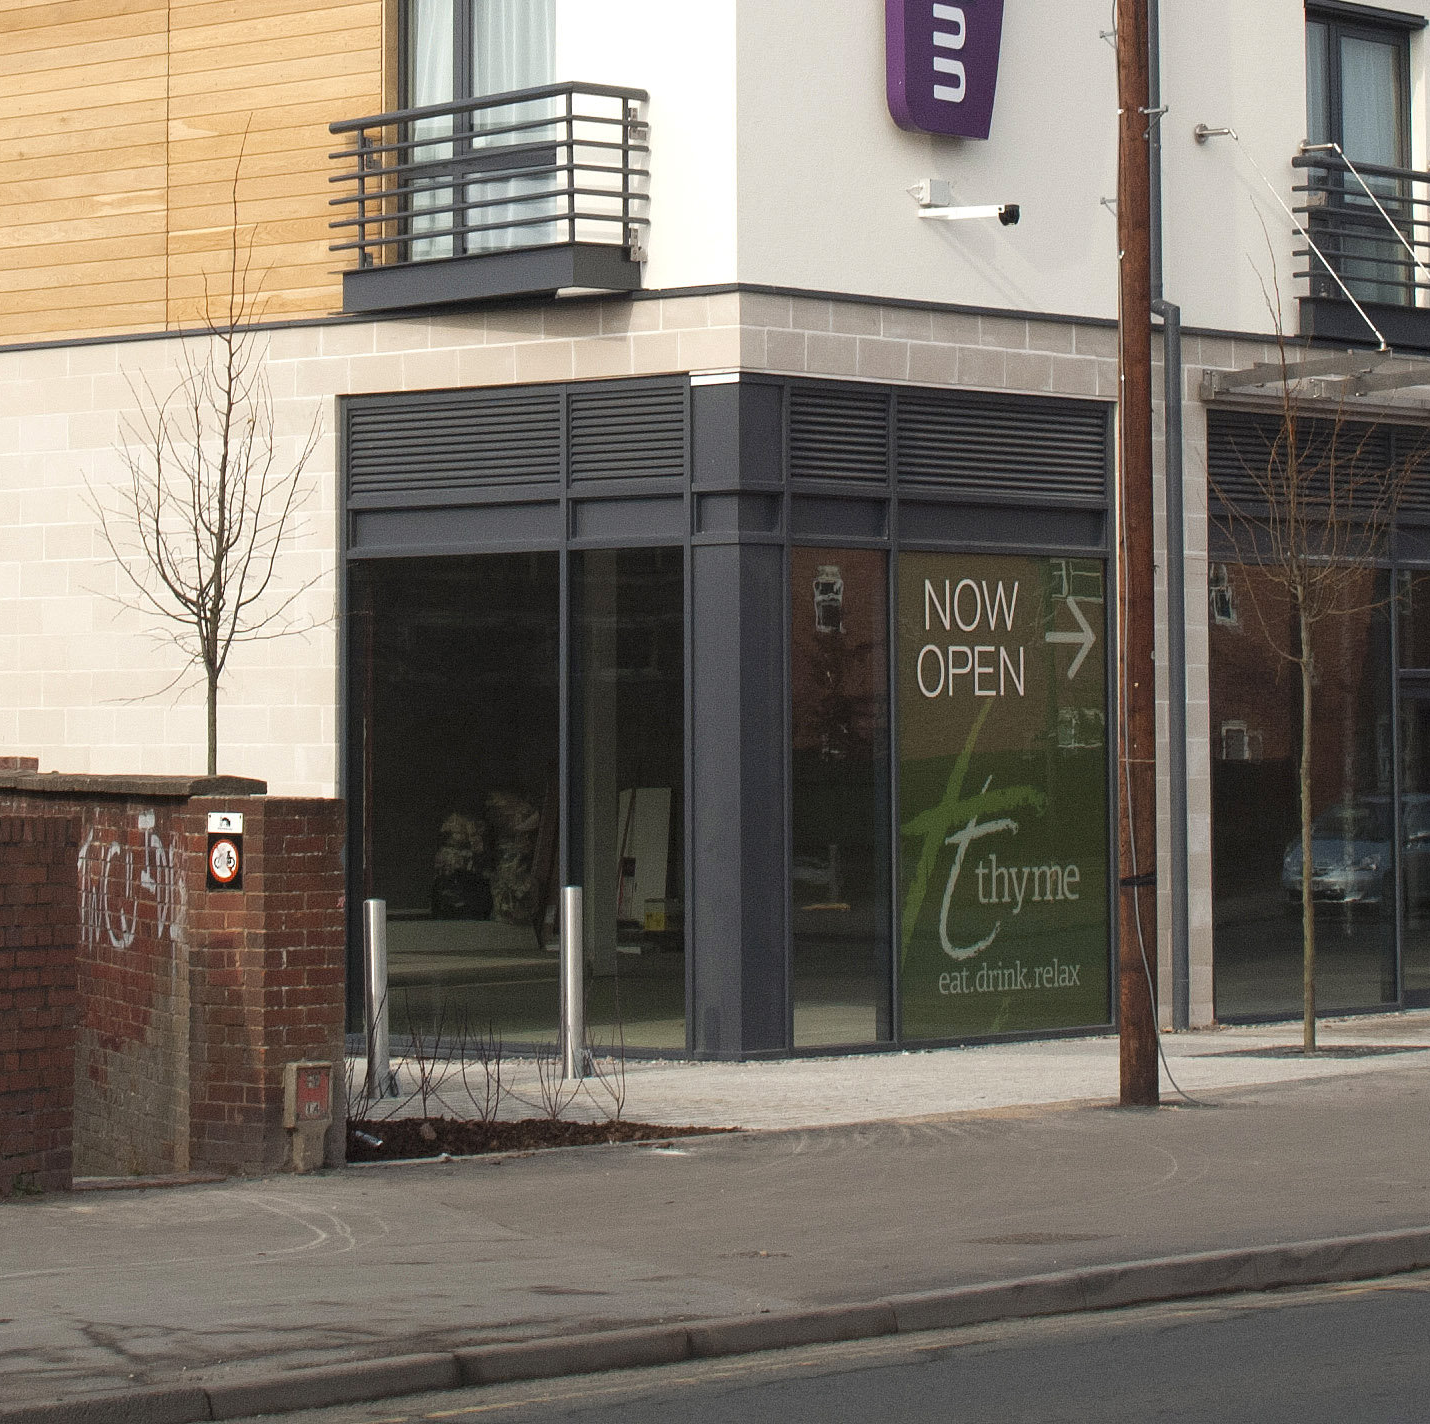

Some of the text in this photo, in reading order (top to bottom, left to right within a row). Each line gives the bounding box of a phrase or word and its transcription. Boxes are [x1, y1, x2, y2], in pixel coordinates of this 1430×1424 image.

[924, 578, 1019, 632] NOW
[917, 644, 1025, 698] OPEN
[975, 853, 1081, 914] thyme
[938, 958, 1082, 995] eat.drink.relax
